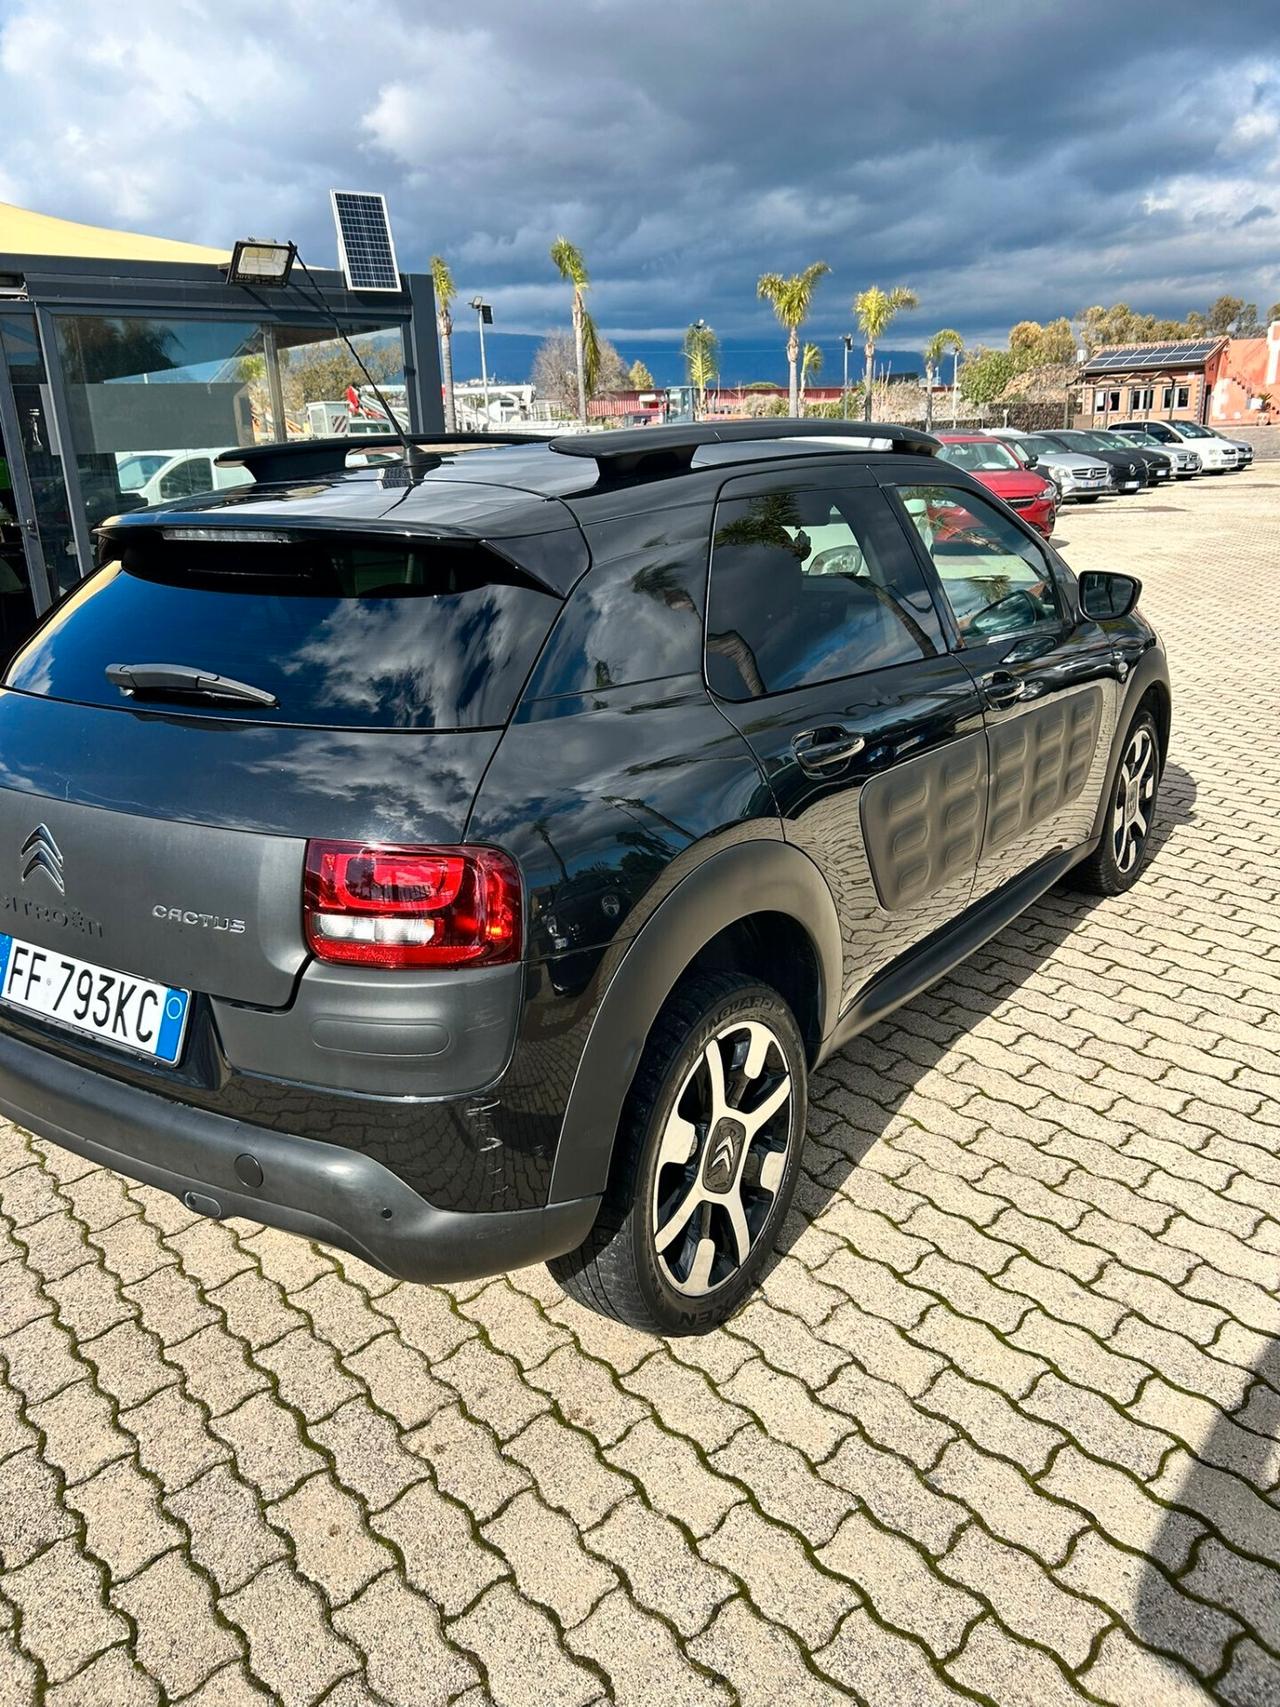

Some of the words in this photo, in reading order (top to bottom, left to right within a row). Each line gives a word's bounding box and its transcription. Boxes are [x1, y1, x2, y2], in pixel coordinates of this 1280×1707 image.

[152, 904, 247, 934] CACTUS
[8, 945, 46, 1000] FF
[52, 961, 160, 1043] 793KC
